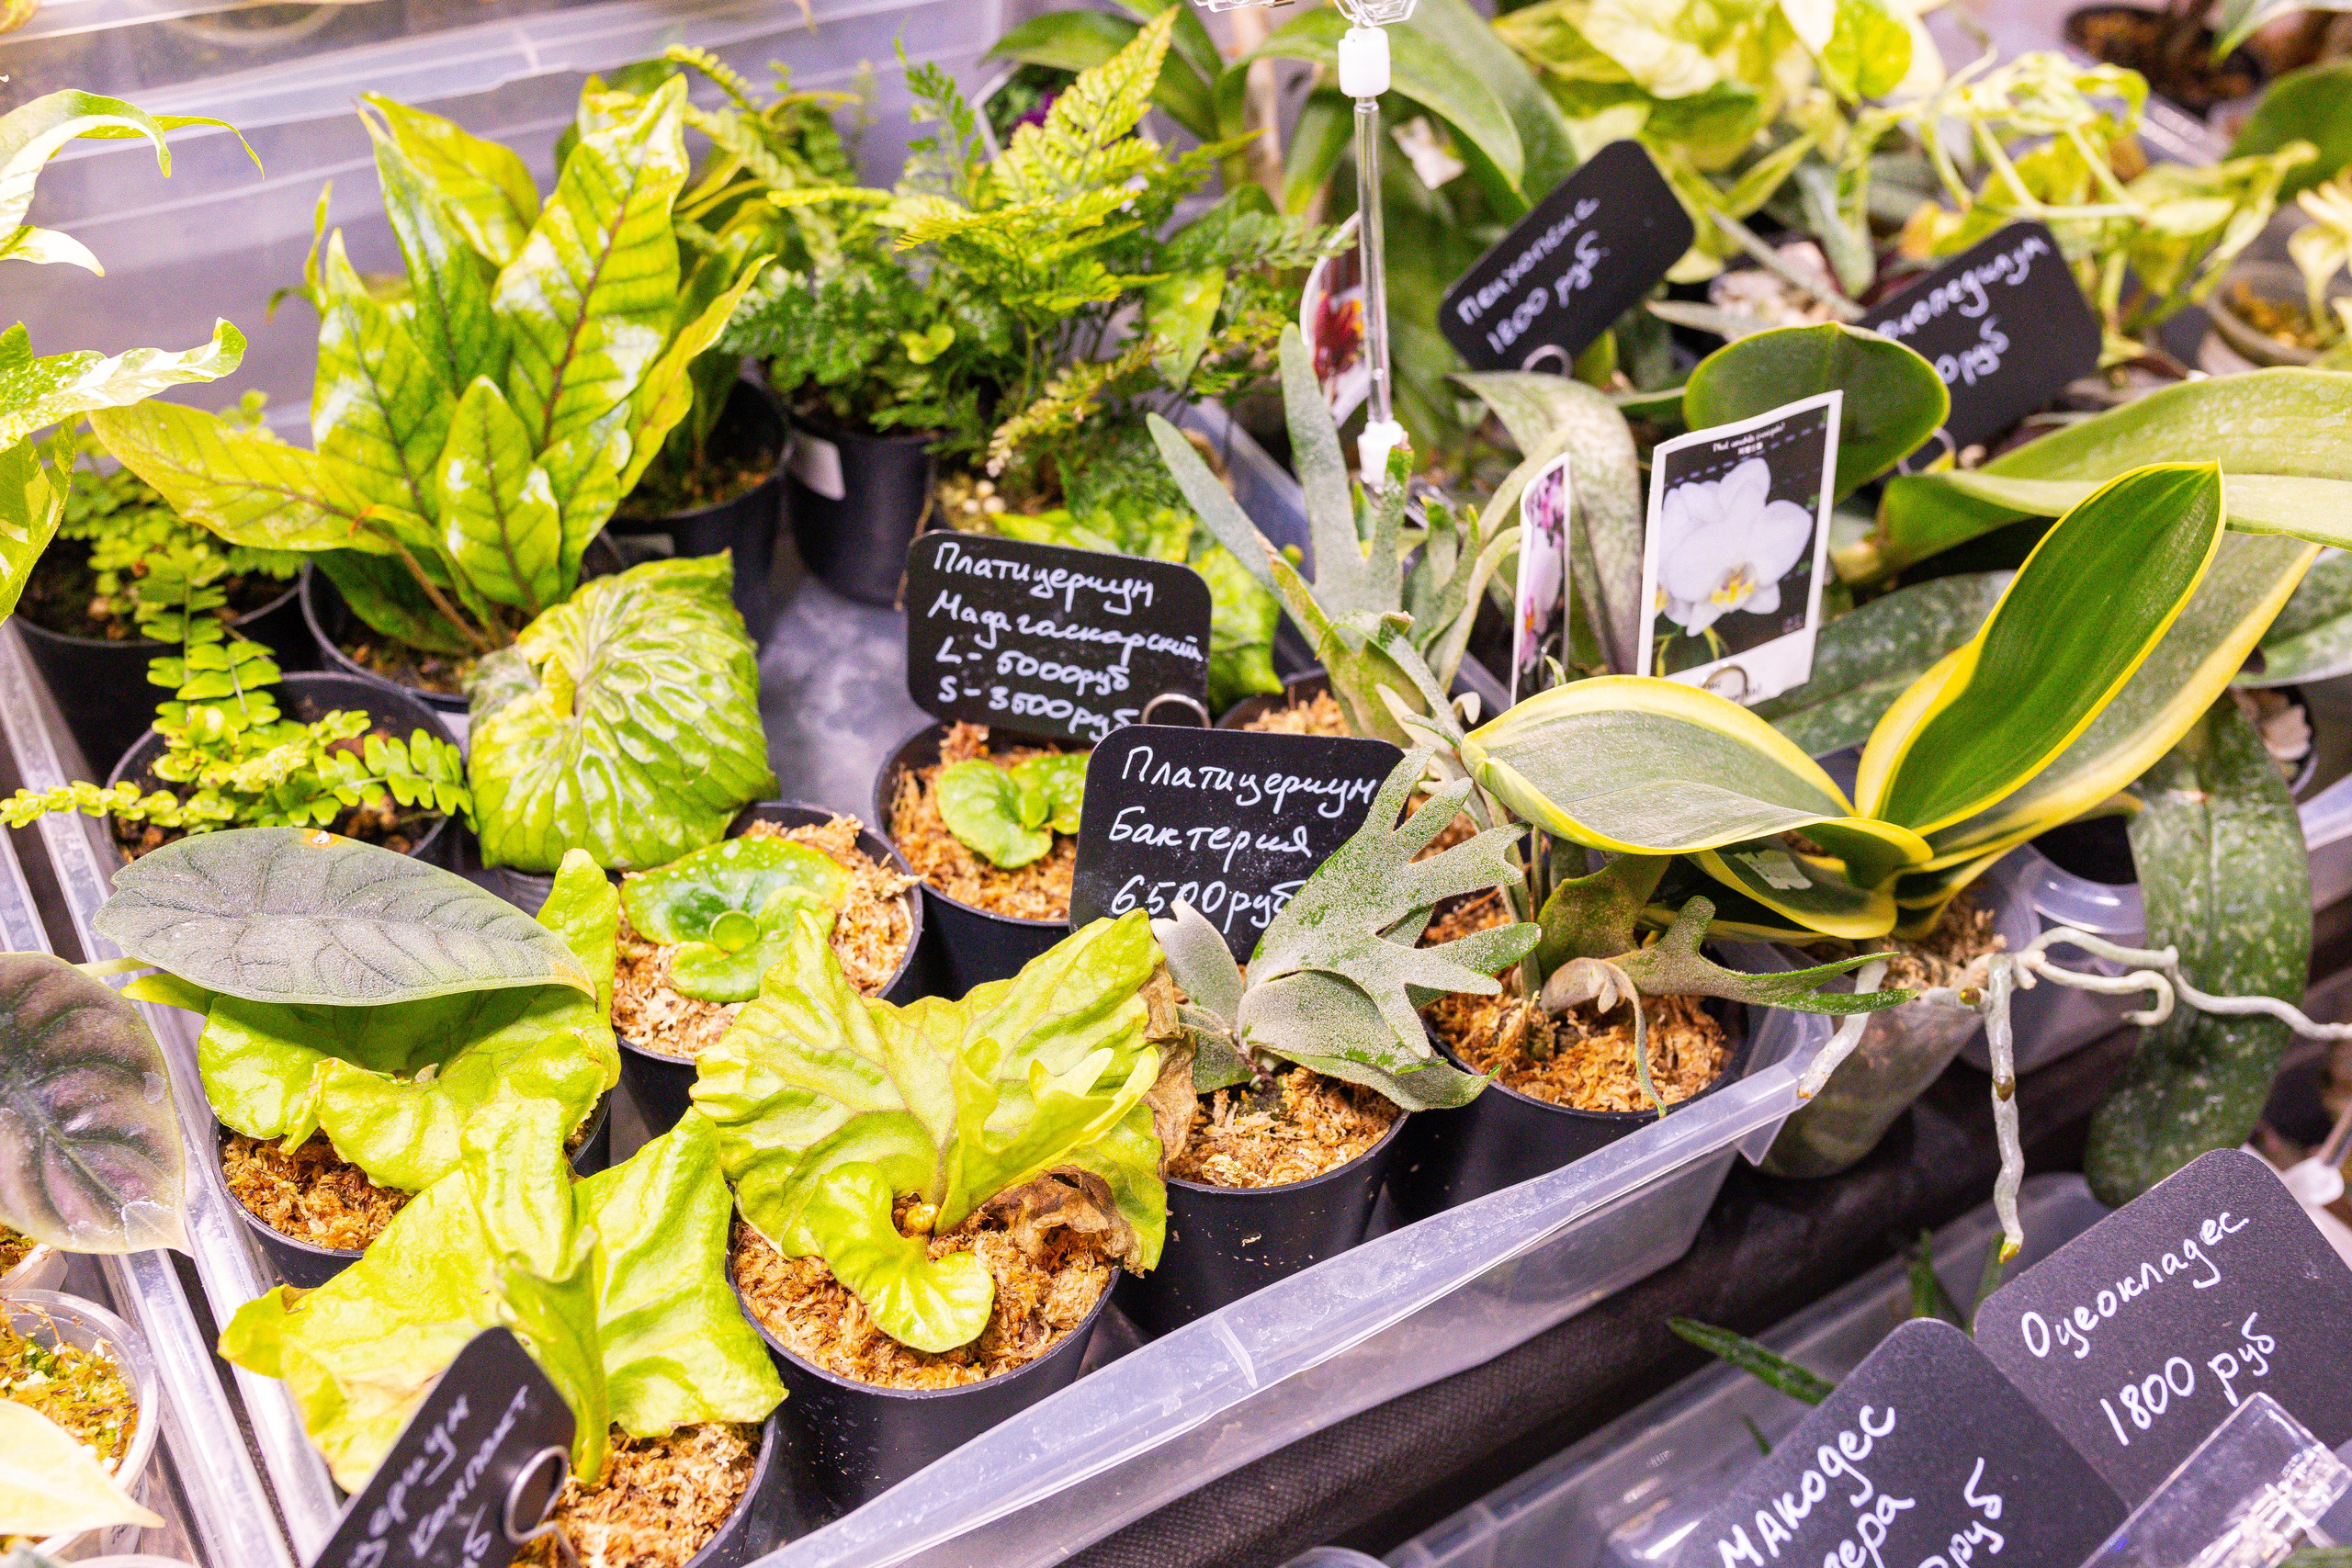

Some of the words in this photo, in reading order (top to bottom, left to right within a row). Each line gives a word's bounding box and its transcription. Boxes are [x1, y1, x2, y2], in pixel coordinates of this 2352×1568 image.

[1486, 287, 1549, 354] 1800
[1554, 230, 1600, 308] руб
[933, 542, 1154, 616] Платицериум
[1122, 745, 1377, 818] Платицериум
[1108, 806, 1312, 874] Бактерия
[2021, 1212, 2250, 1359] Оцеокладес
[2099, 1356, 2195, 1446] 1800
[2207, 1311, 2276, 1408] руб
